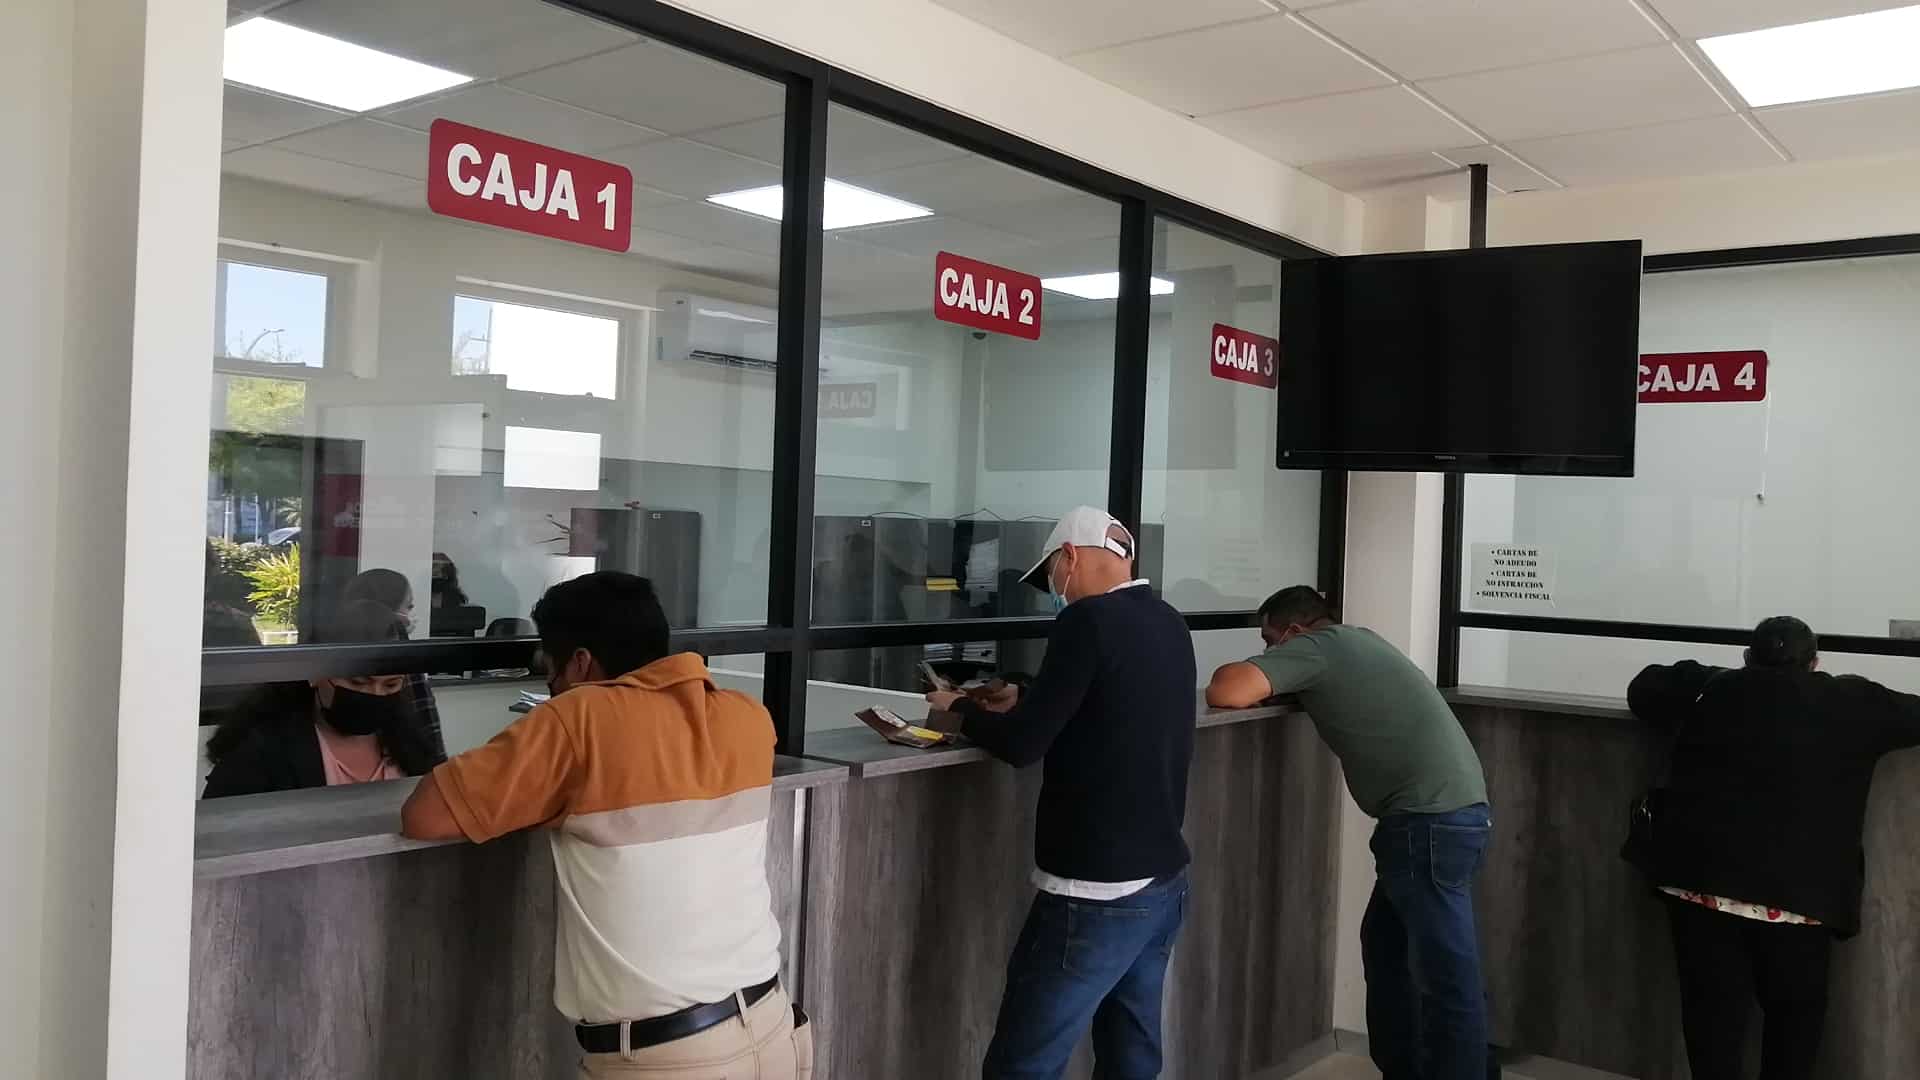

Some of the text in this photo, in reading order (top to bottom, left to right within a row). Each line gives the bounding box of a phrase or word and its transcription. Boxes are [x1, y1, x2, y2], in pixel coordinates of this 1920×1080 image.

[447, 143, 617, 231] CAJA 1
[940, 267, 1034, 325] CAJA 2
[1214, 335, 1273, 377] CAJA 3
[1637, 361, 1756, 392] CAJA 4
[1496, 549, 1527, 557] CARTAS
[1507, 559, 1537, 567] ADEUDO
[1481, 591, 1523, 599] SOLVENCIA
